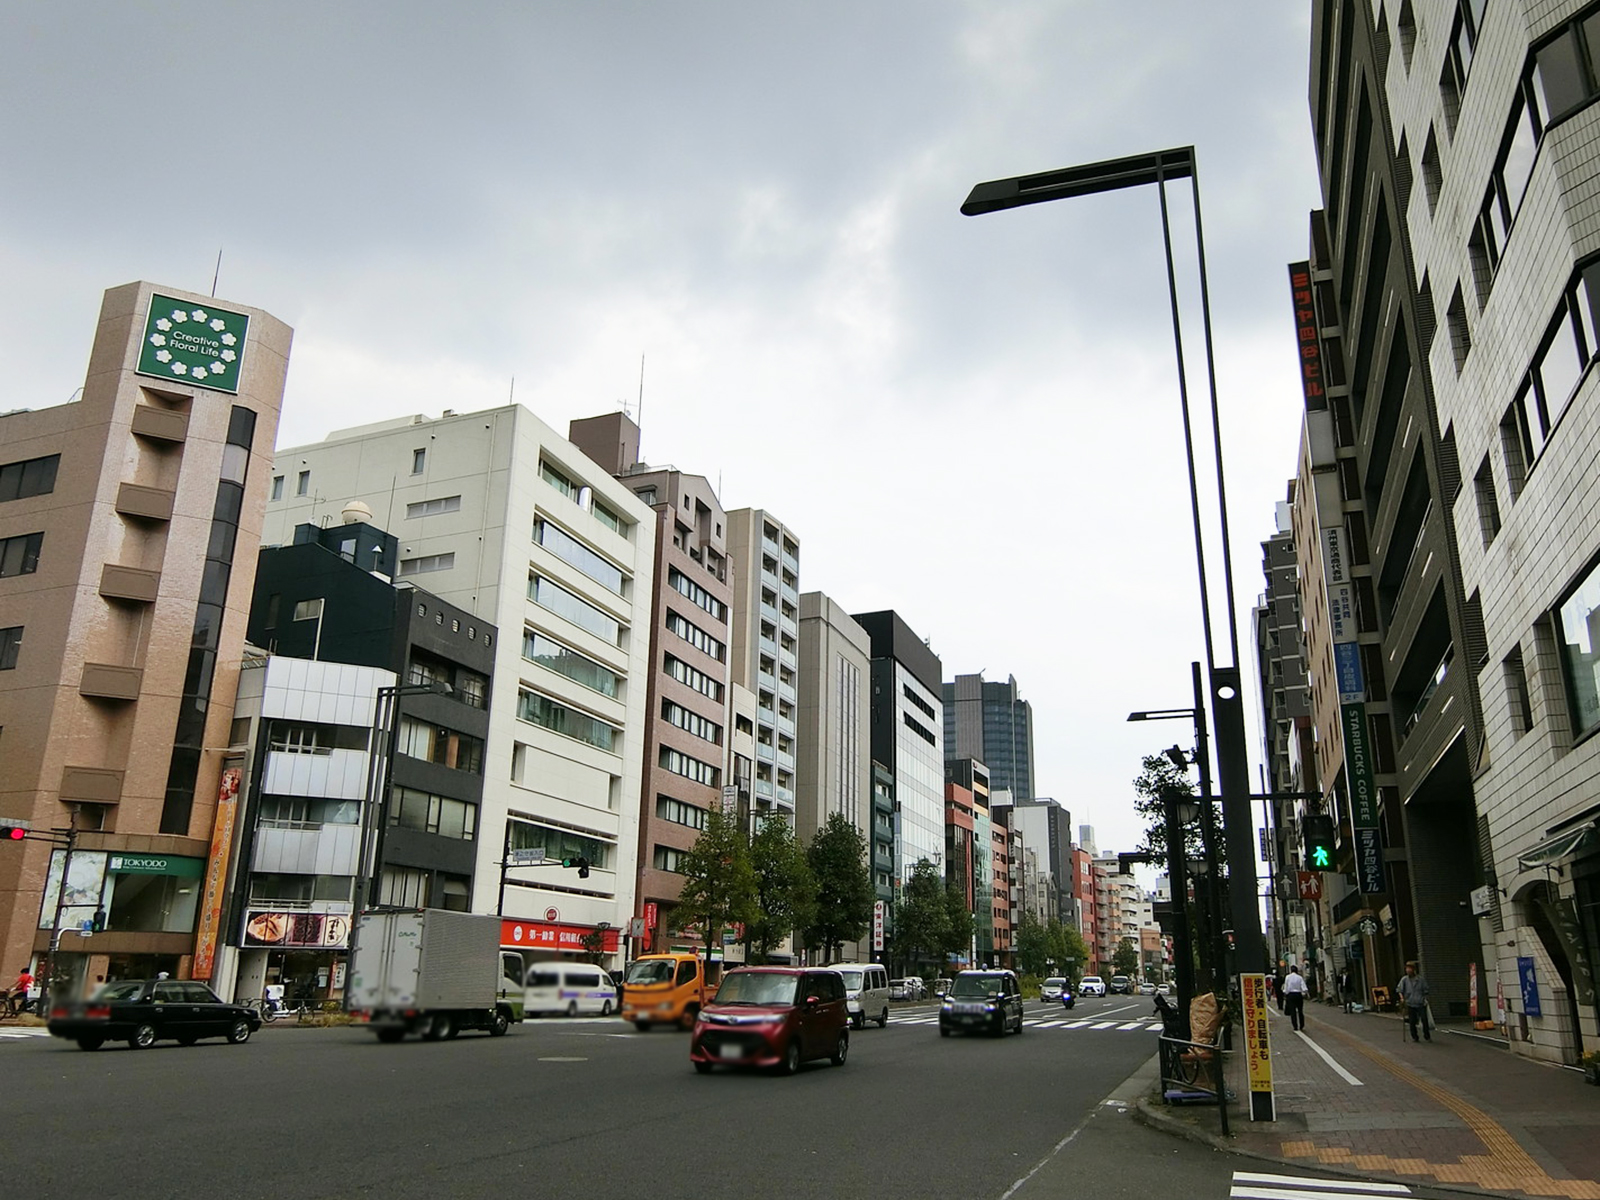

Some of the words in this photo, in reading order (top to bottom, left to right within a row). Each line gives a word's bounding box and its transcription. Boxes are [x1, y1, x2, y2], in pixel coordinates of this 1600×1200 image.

[170, 340, 198, 352] Floral
[201, 347, 219, 357] Life
[173, 331, 219, 348] Creative
[1293, 273, 1323, 396] ミツヤ四谷ビル
[1349, 710, 1365, 775] STARBUCKS
[1357, 779, 1370, 821] COFFEE
[123, 858, 167, 868] TOKYODO
[1361, 830, 1379, 892] ミツヤ四谷ビル
[1243, 977, 1260, 1076] 信号を守りましょう。
[1254, 978, 1269, 1060] 歩行者・自転車も
